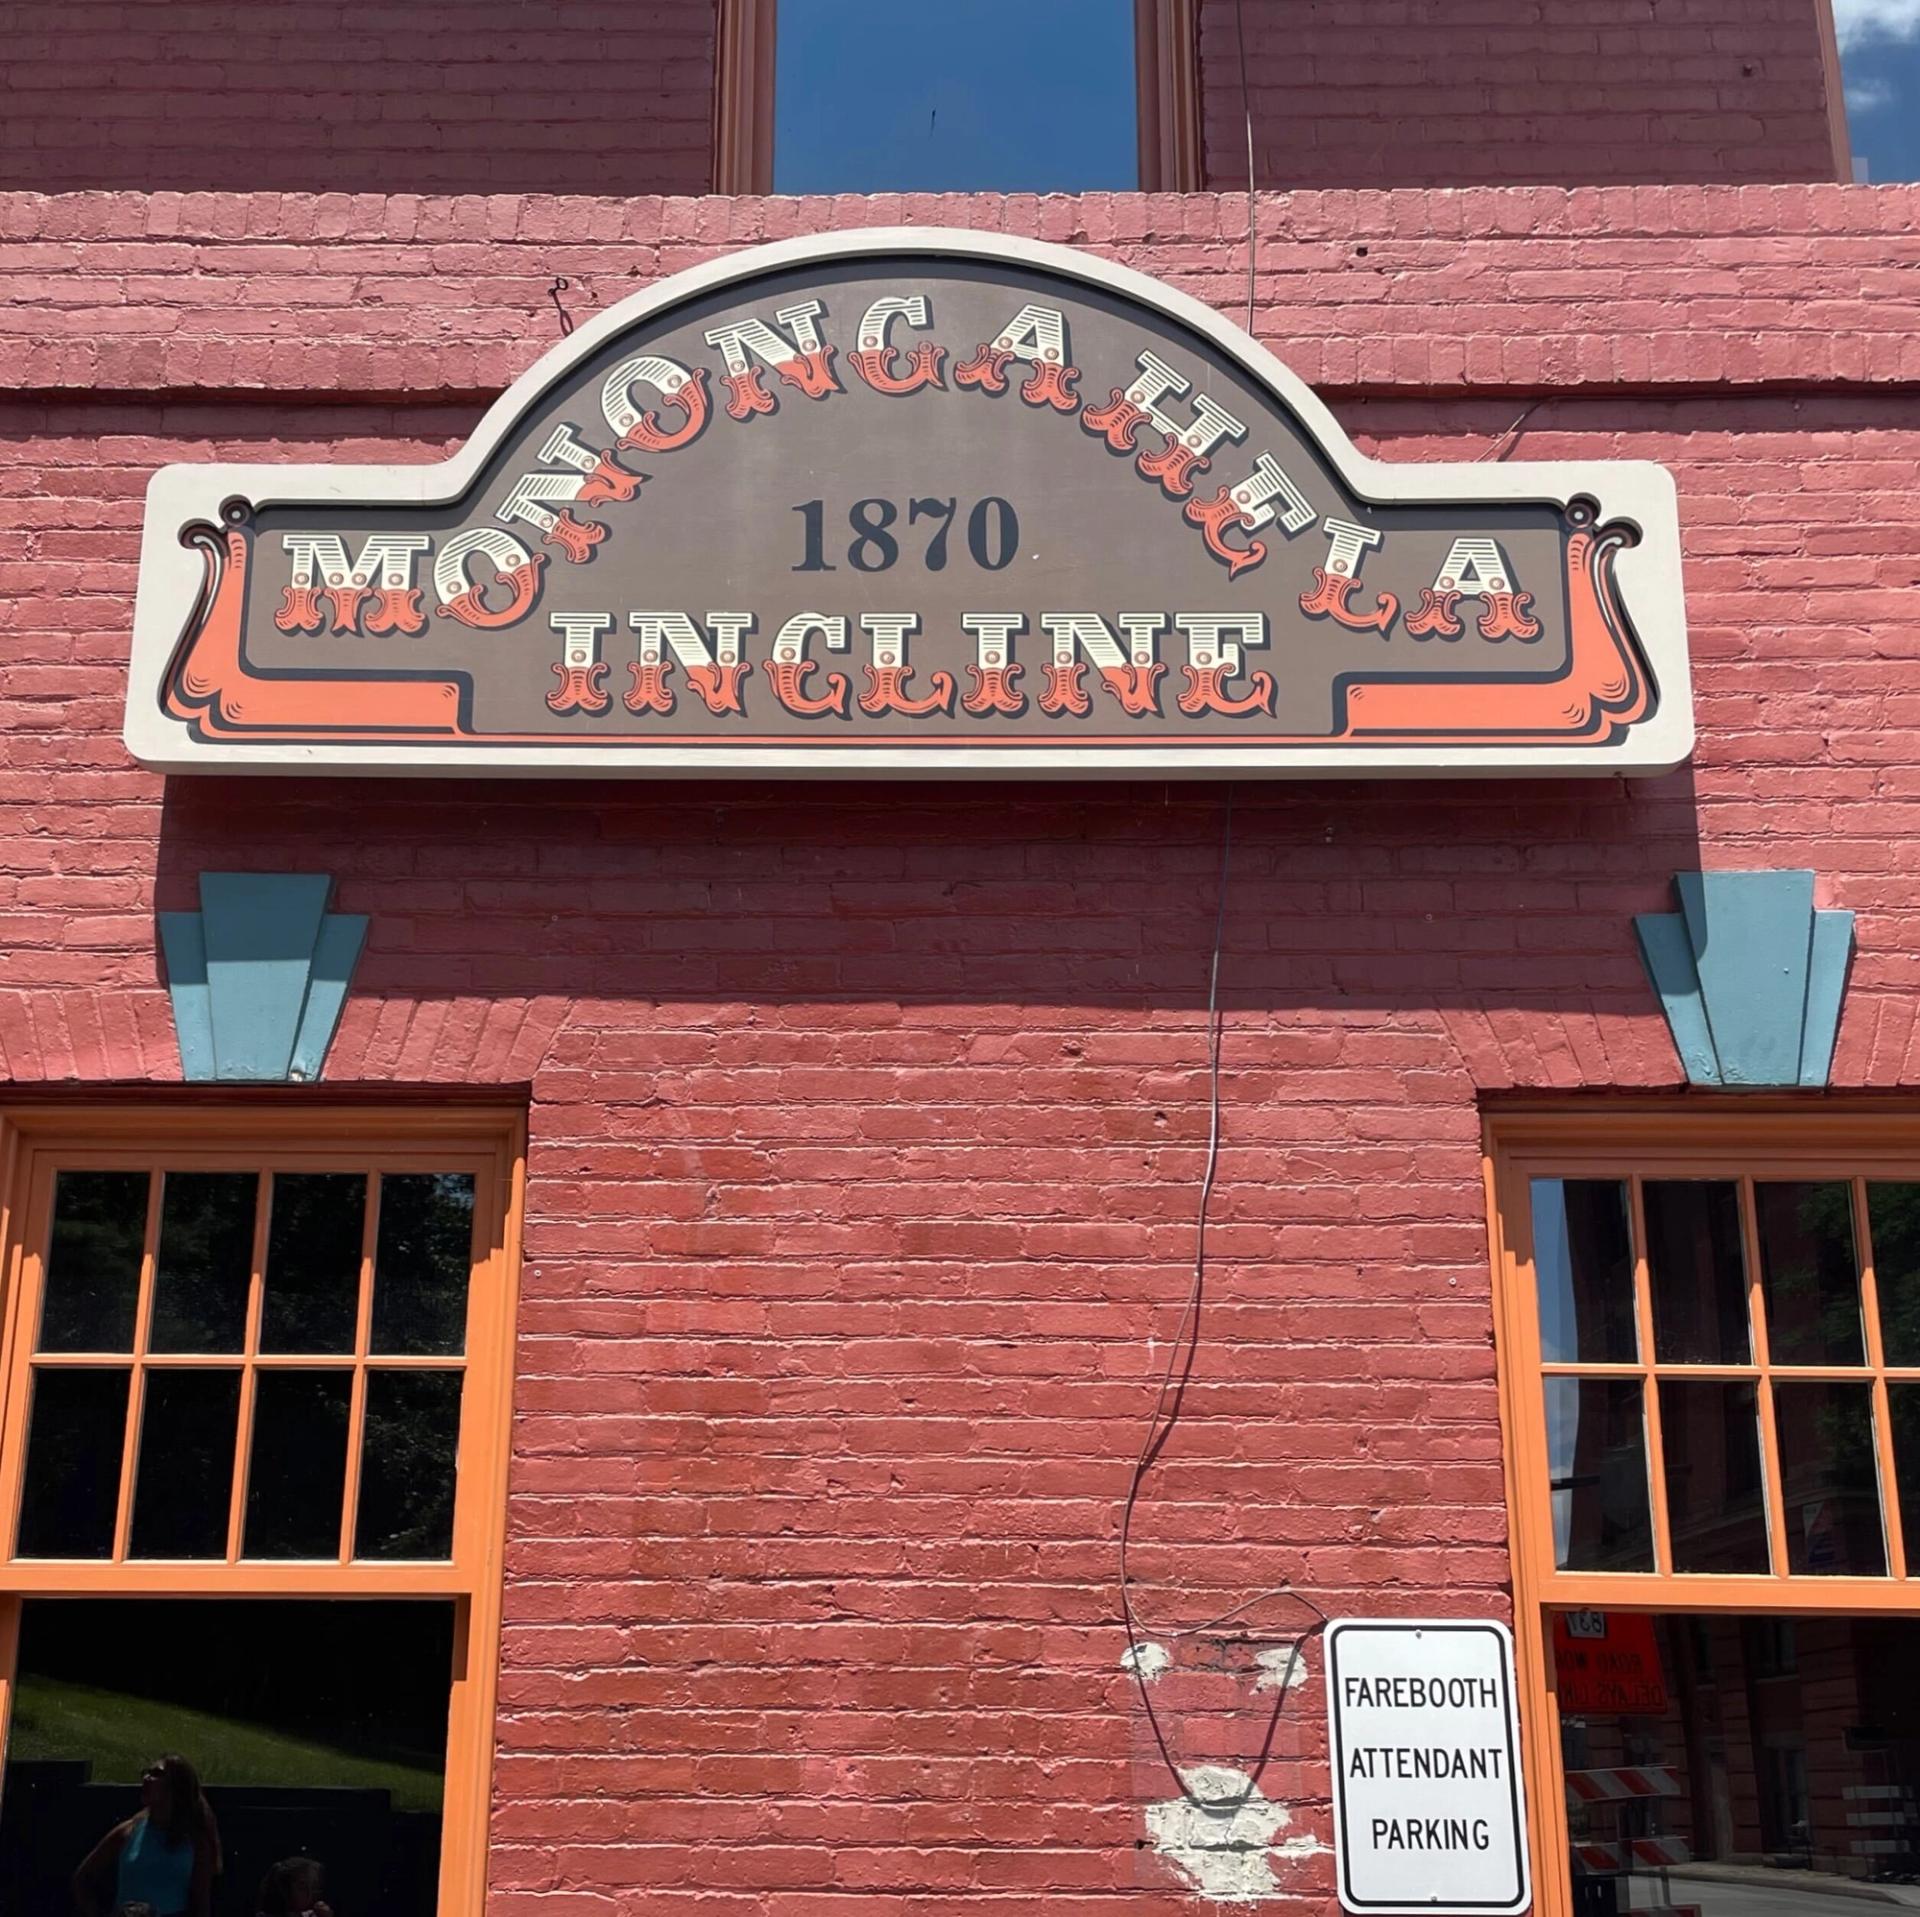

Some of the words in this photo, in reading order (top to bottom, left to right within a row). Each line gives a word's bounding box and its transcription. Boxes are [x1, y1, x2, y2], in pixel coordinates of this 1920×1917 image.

[275, 295, 1540, 640] MONONGAHELA
[791, 497, 1019, 572] 1870
[546, 611, 1278, 717] INCLINE
[1345, 1677, 1498, 1708] FAREBOOTH
[1349, 1748, 1502, 1778] ATTENDANT
[1372, 1819, 1490, 1850] PARKING
